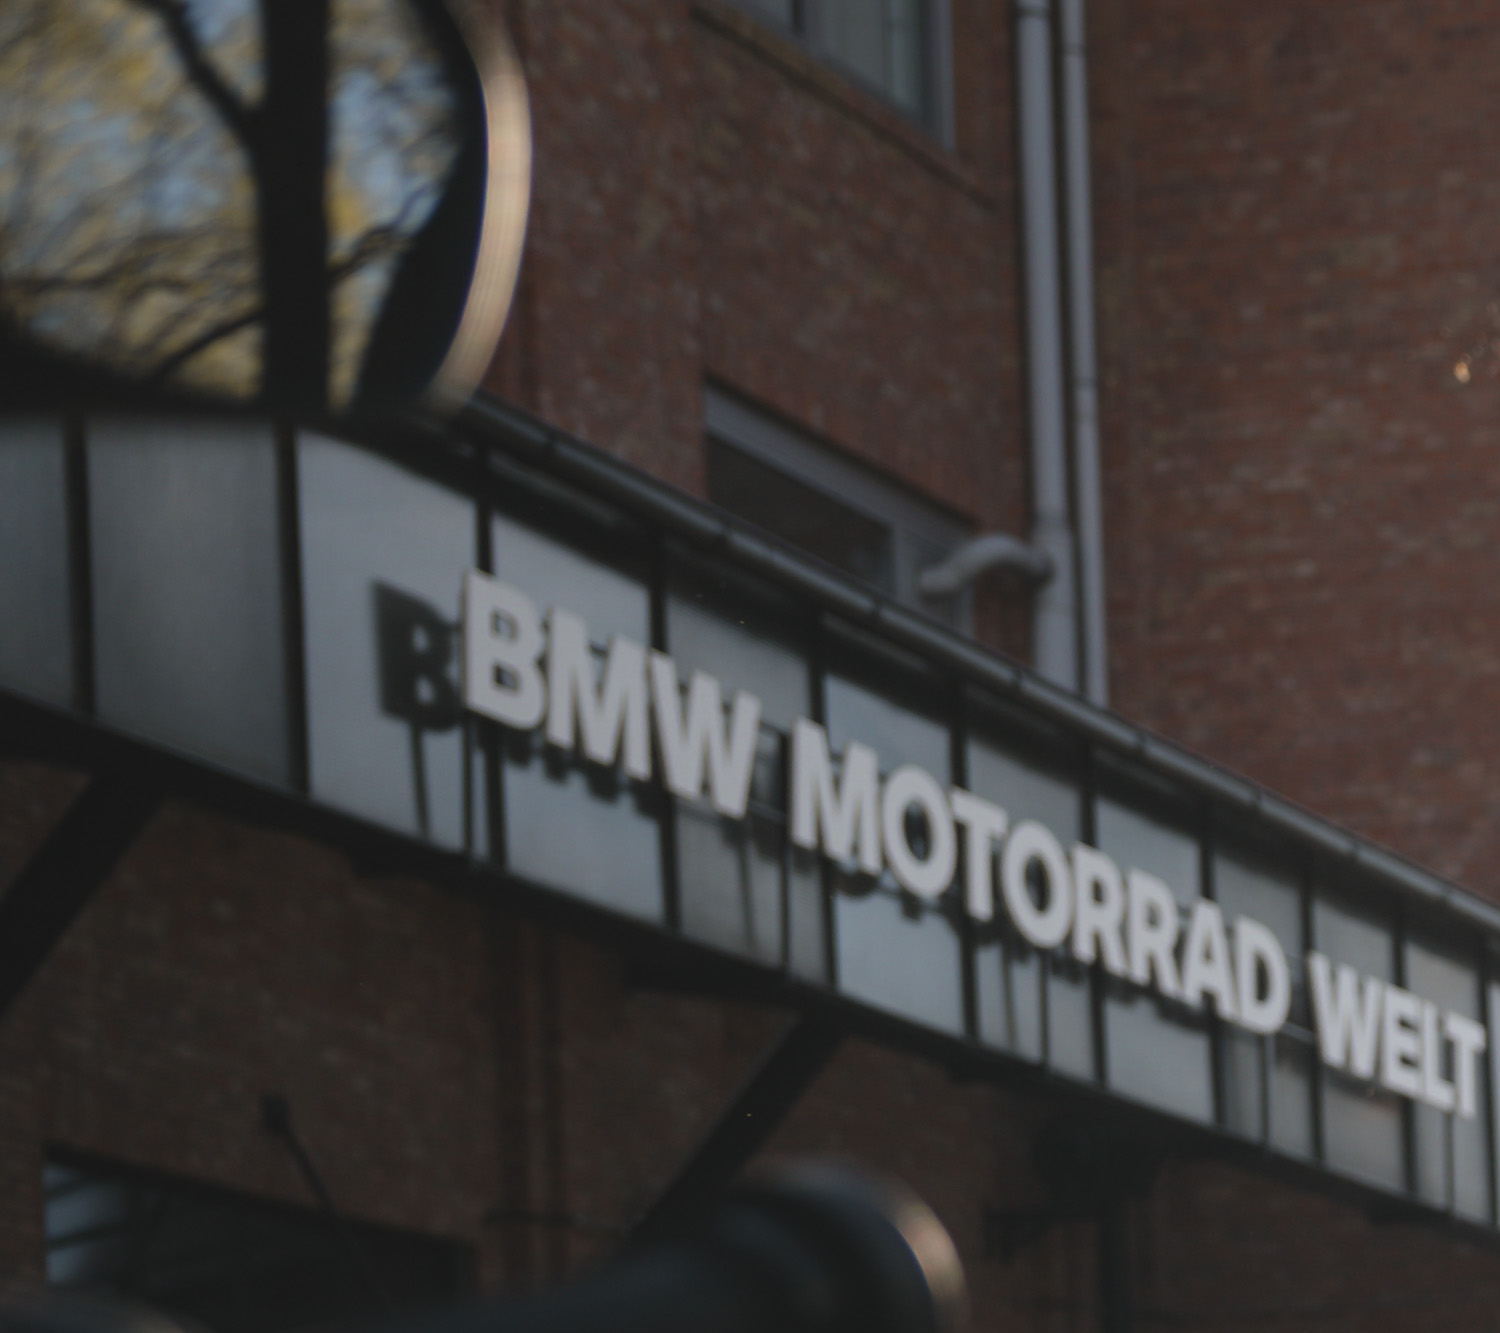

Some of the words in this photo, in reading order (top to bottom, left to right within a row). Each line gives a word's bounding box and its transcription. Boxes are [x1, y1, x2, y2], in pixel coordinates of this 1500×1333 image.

[464, 568, 761, 818] BMW
[790, 716, 1291, 1036] MOTORRAD
[1309, 951, 1488, 1118] WELT
